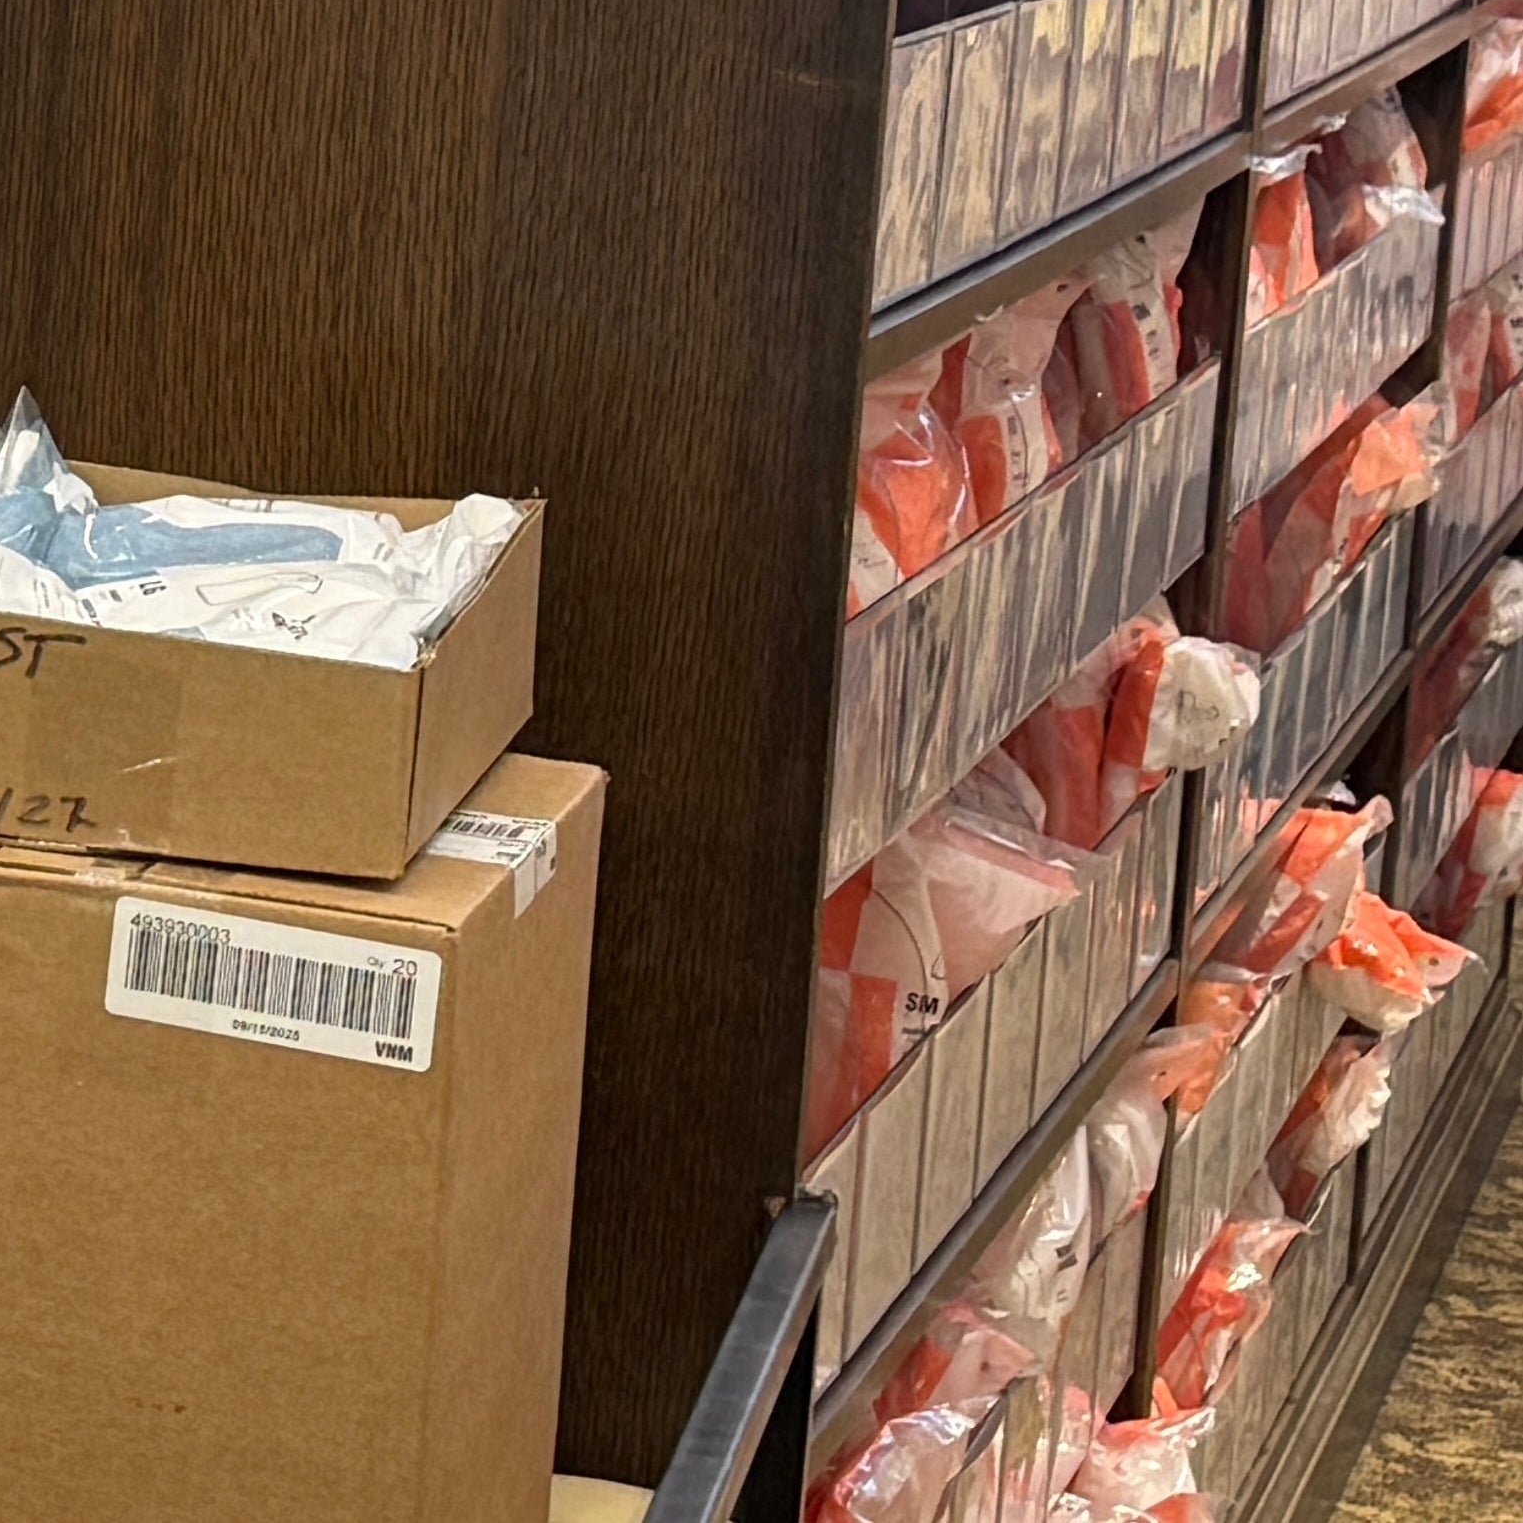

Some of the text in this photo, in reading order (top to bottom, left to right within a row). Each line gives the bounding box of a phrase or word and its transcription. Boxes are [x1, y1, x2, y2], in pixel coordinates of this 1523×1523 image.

[129, 911, 233, 945] 493930003
[391, 958, 419, 977] 20
[905, 991, 940, 1016] SM
[374, 1040, 414, 1063] VNM
